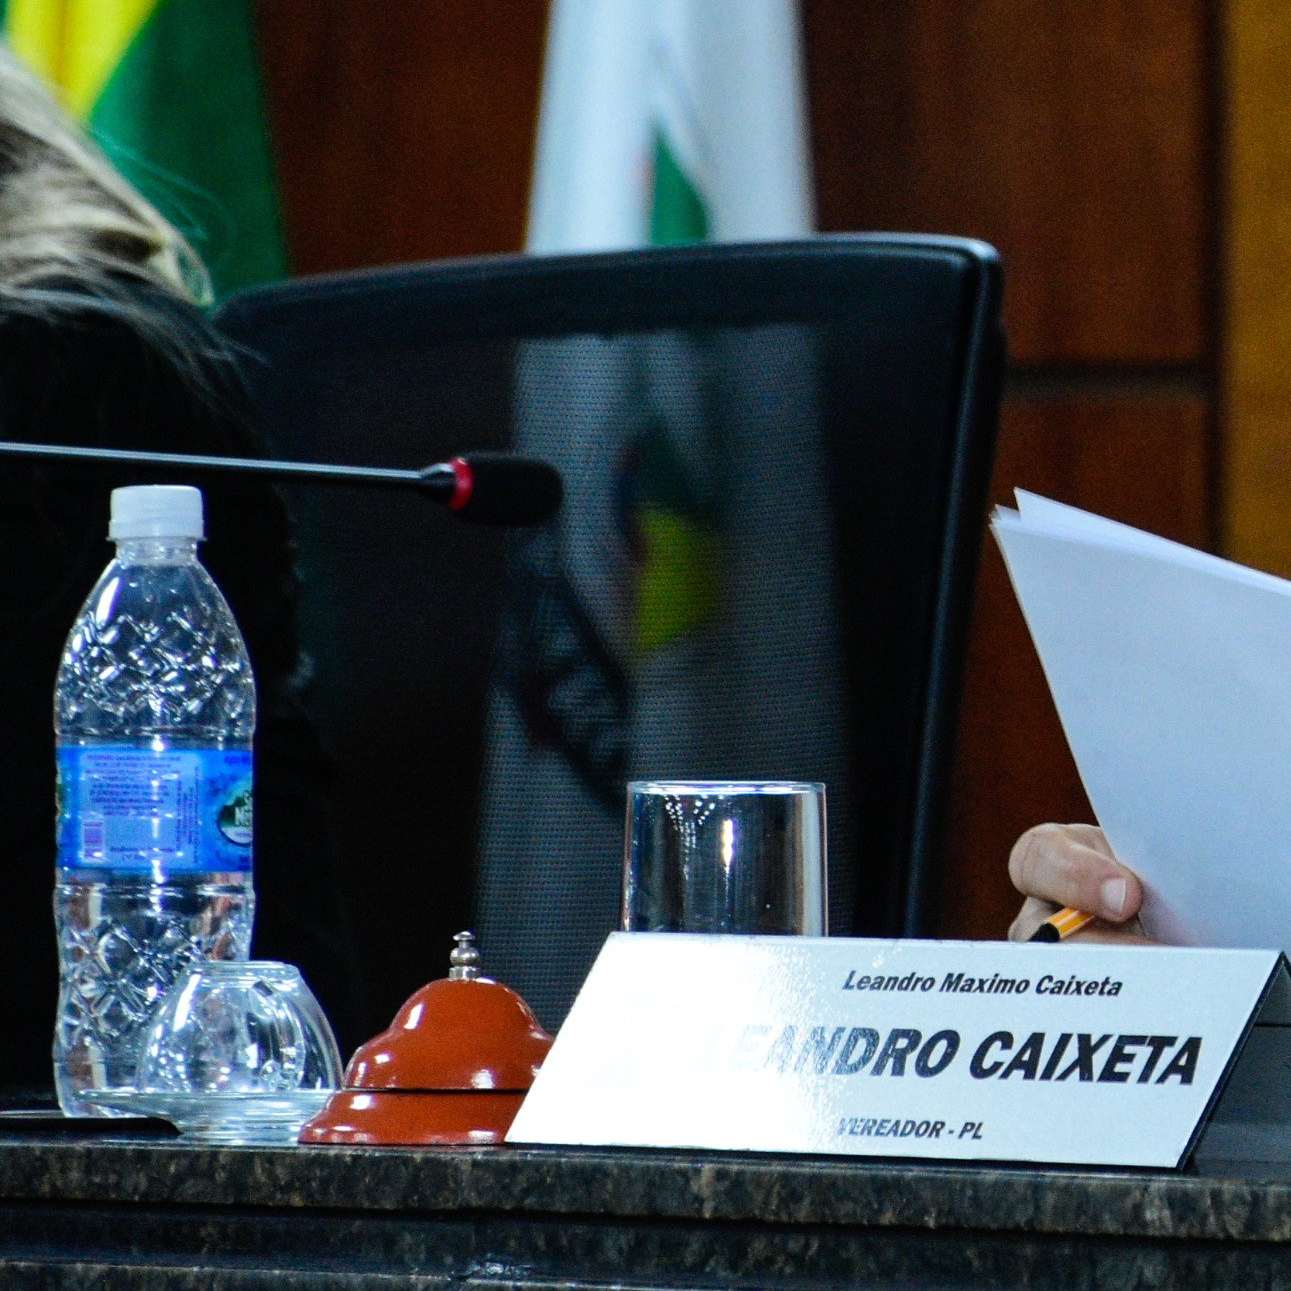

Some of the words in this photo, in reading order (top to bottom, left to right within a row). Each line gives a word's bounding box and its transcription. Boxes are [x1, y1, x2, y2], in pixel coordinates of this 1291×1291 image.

[842, 970, 936, 992] Leandro
[939, 972, 1030, 994] Maximo
[1035, 974, 1123, 997] Caixeta
[969, 1030, 1203, 1086] CAIXETA
[838, 1117, 946, 1139] VEREADOR
[958, 1121, 984, 1140] PL
